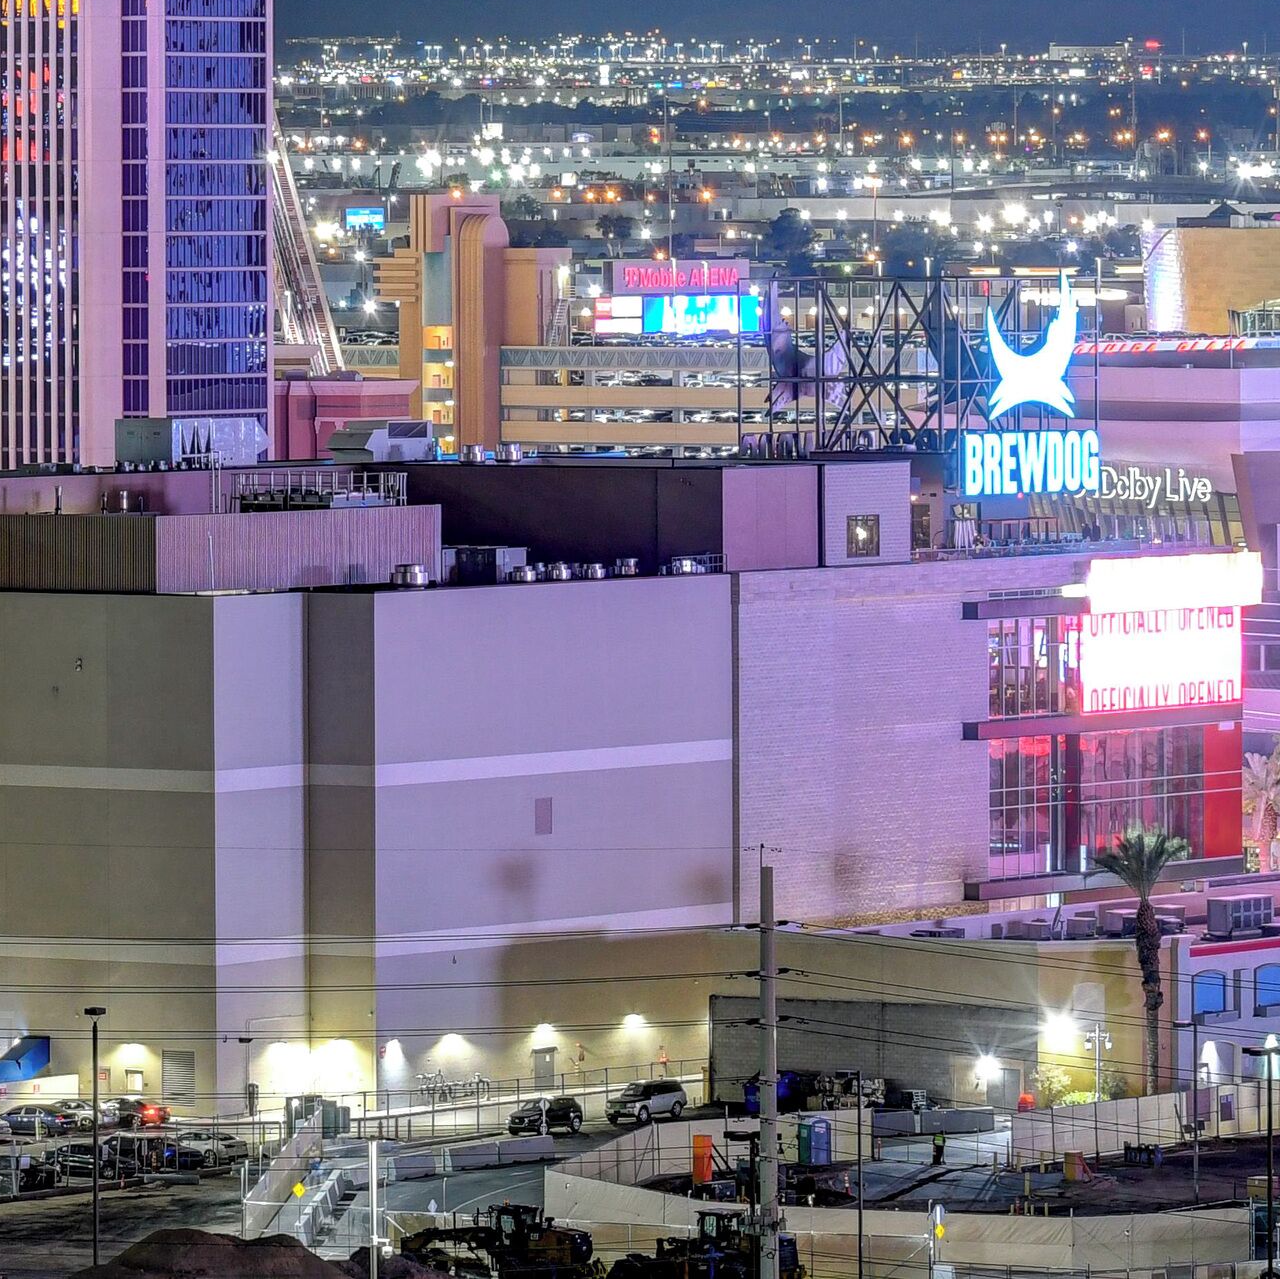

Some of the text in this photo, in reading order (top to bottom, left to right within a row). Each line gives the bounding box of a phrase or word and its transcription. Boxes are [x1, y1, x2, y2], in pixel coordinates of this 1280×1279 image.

[690, 267, 739, 287] ARENA
[964, 430, 1100, 496] BREWDOG
[1101, 466, 1212, 508] Dolby Live
